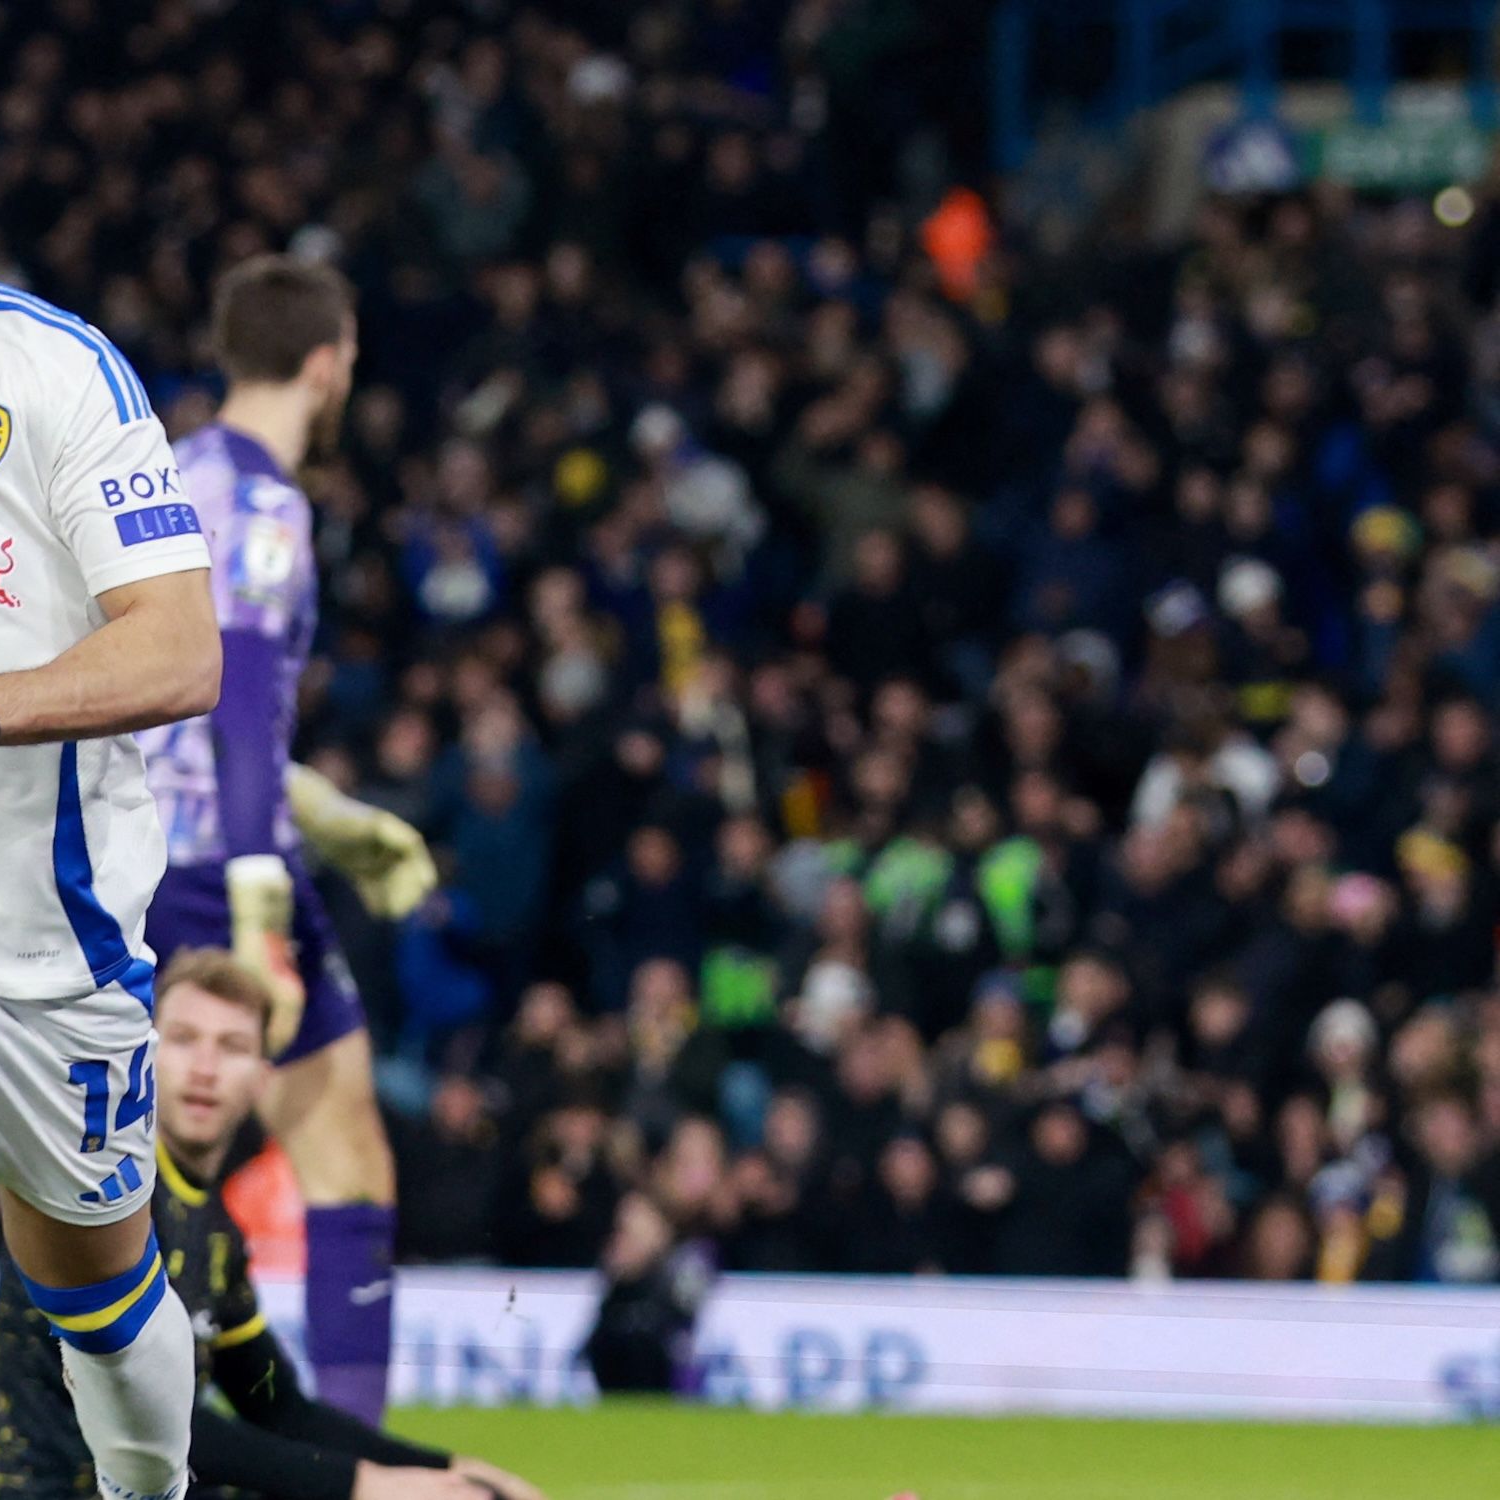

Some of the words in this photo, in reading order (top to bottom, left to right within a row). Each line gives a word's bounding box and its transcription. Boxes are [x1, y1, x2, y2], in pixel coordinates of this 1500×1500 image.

[100, 467, 180, 507] BOX
[135, 506, 196, 539] LIFE
[68, 1040, 155, 1153] 14
